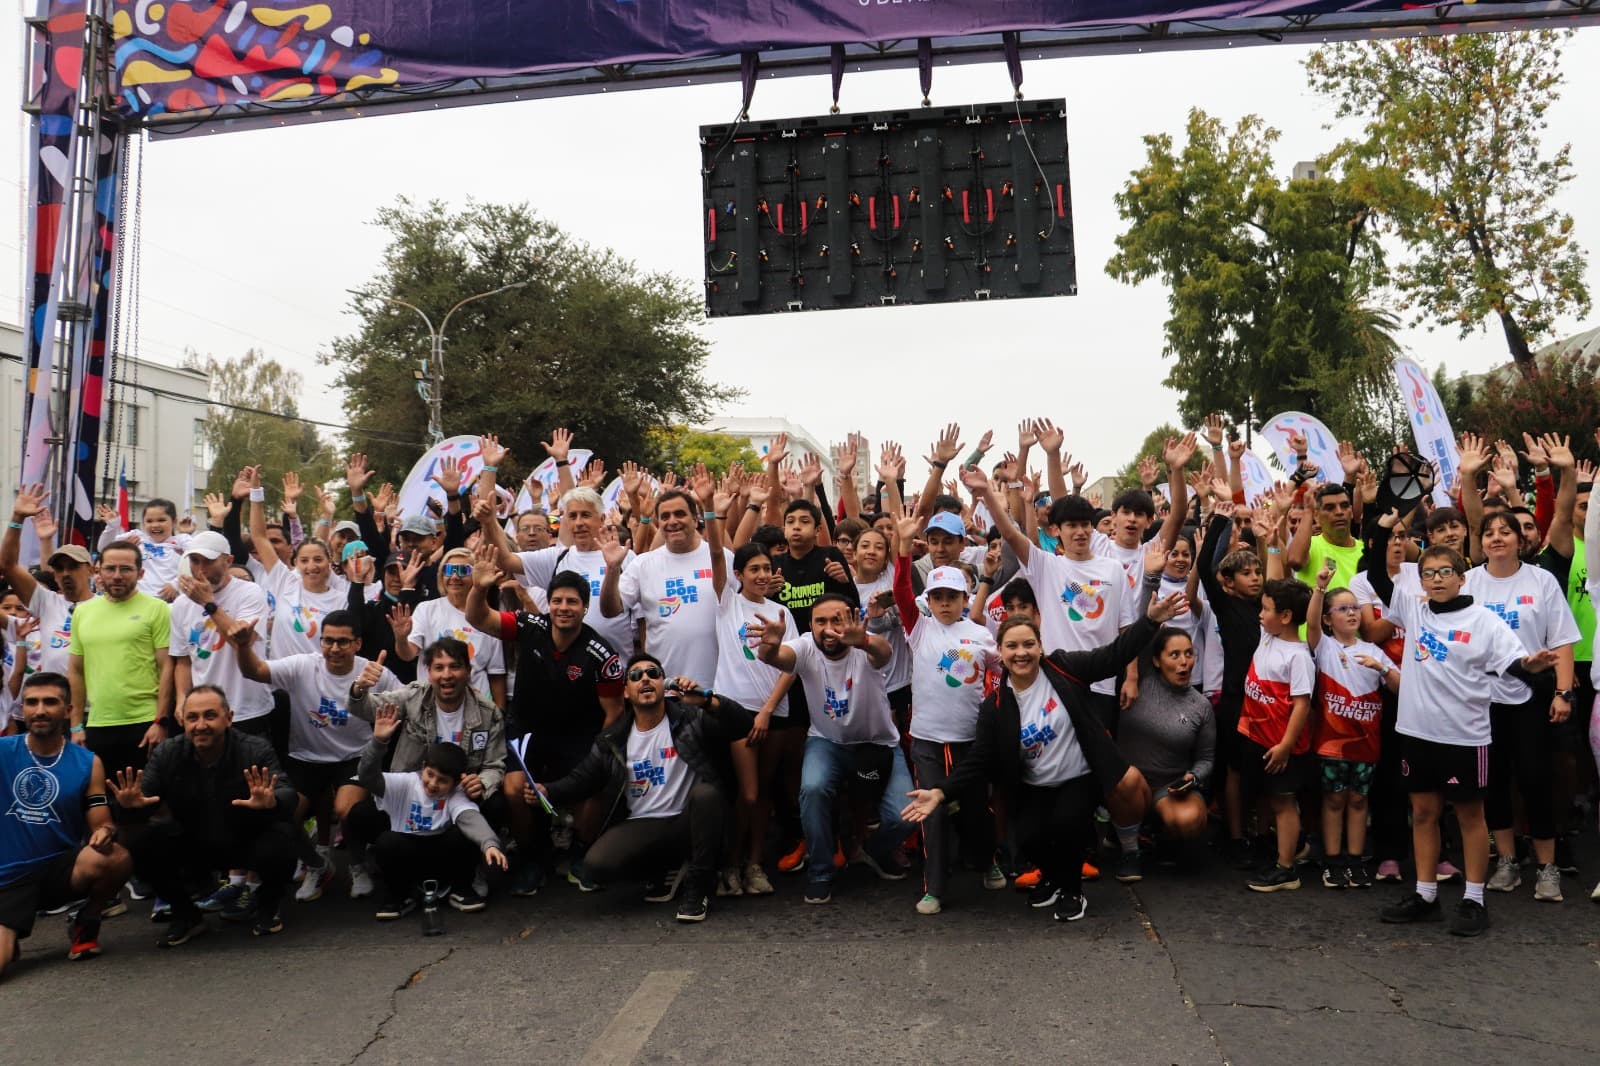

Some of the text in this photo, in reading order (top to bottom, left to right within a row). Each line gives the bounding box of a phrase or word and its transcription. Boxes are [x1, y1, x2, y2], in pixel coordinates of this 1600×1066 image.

[665, 579, 684, 588] DE
[666, 586, 697, 597] POR
[681, 594, 698, 603] TE
[1324, 692, 1347, 704] CLUB
[1327, 701, 1377, 722] YUNGAY
[1020, 723, 1038, 740] DE
[632, 759, 653, 771] DE
[634, 766, 664, 780] POR
[650, 776, 666, 787] TE
